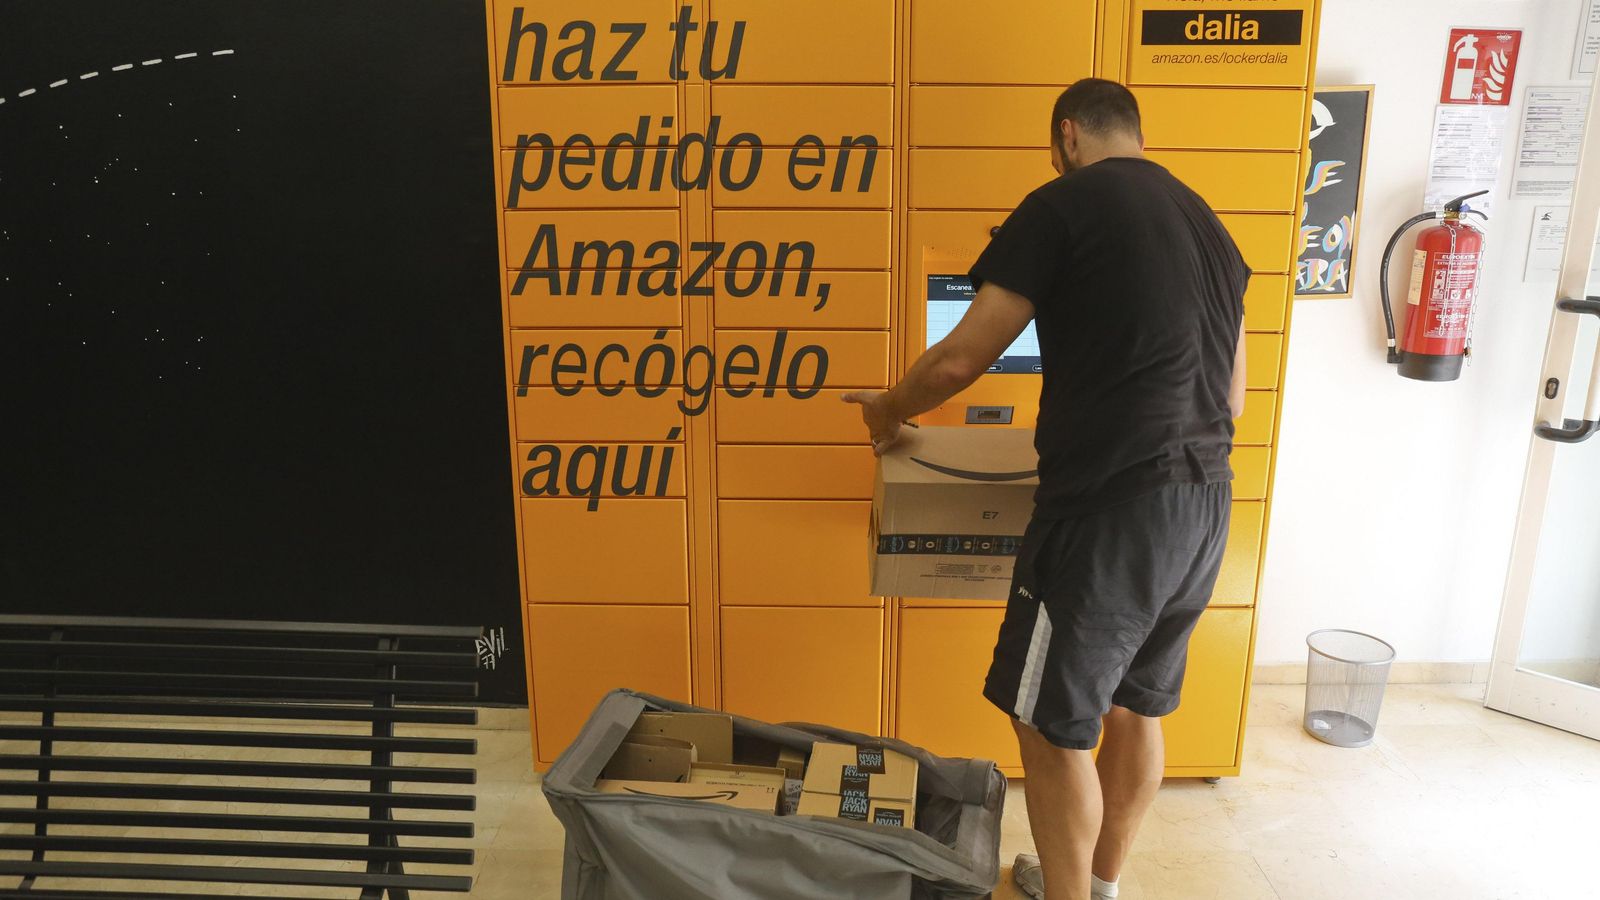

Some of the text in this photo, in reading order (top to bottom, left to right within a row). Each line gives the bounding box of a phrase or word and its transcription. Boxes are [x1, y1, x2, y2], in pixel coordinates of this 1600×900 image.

[1184, 13, 1259, 41] dalia
[502, 5, 747, 82] haz tu
[1152, 52, 1288, 64] amazon.es/lockerdalia
[506, 115, 879, 208] pedido en
[510, 223, 831, 312] Amazon,
[516, 328, 829, 416] recógelo
[521, 426, 682, 512] aquí
[982, 511, 999, 520] E7
[858, 753, 882, 761] RYAN
[842, 803, 868, 813] RYAN
[843, 796, 868, 806] JACK
